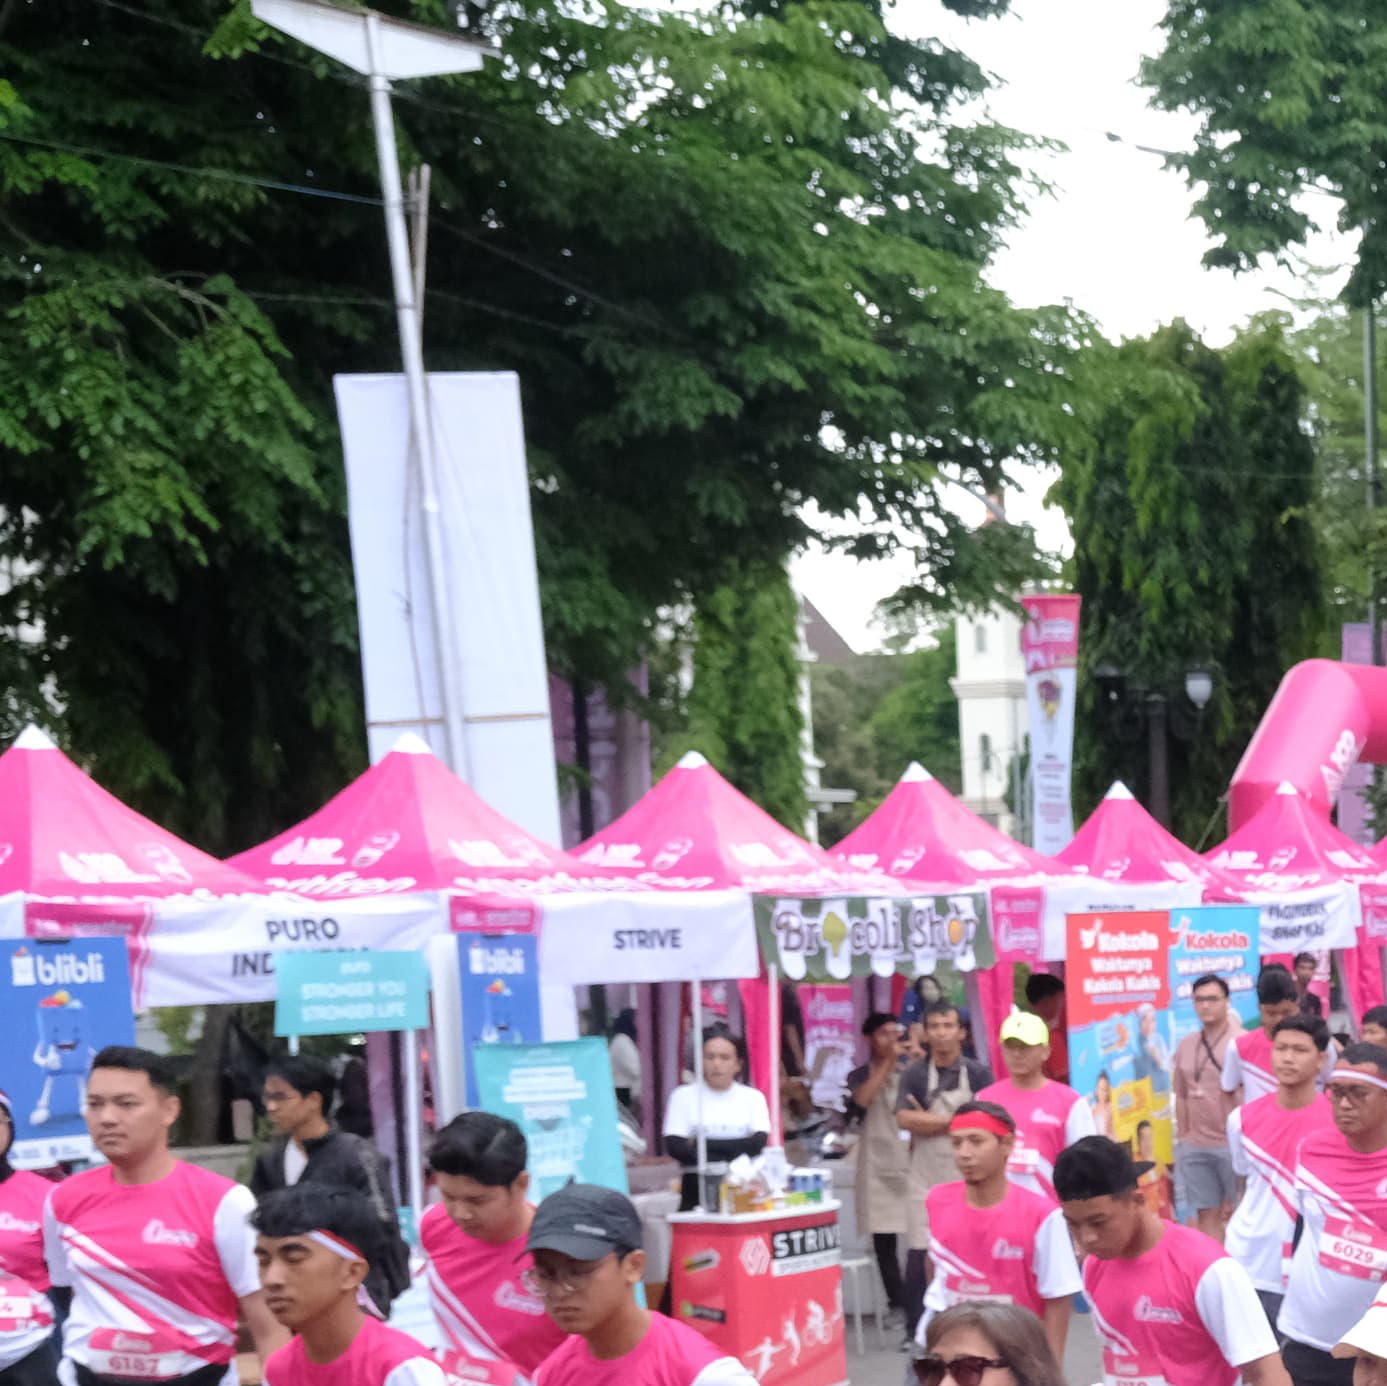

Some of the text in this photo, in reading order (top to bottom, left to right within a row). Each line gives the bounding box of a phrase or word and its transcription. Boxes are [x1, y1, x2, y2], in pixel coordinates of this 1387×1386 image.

[266, 918, 339, 941] PURO
[614, 929, 682, 949] STRIVE
[1186, 932, 1248, 949] Kokola
[36, 953, 104, 984] blibli
[1333, 1241, 1375, 1264] 6029
[109, 1356, 160, 1377] 6187
